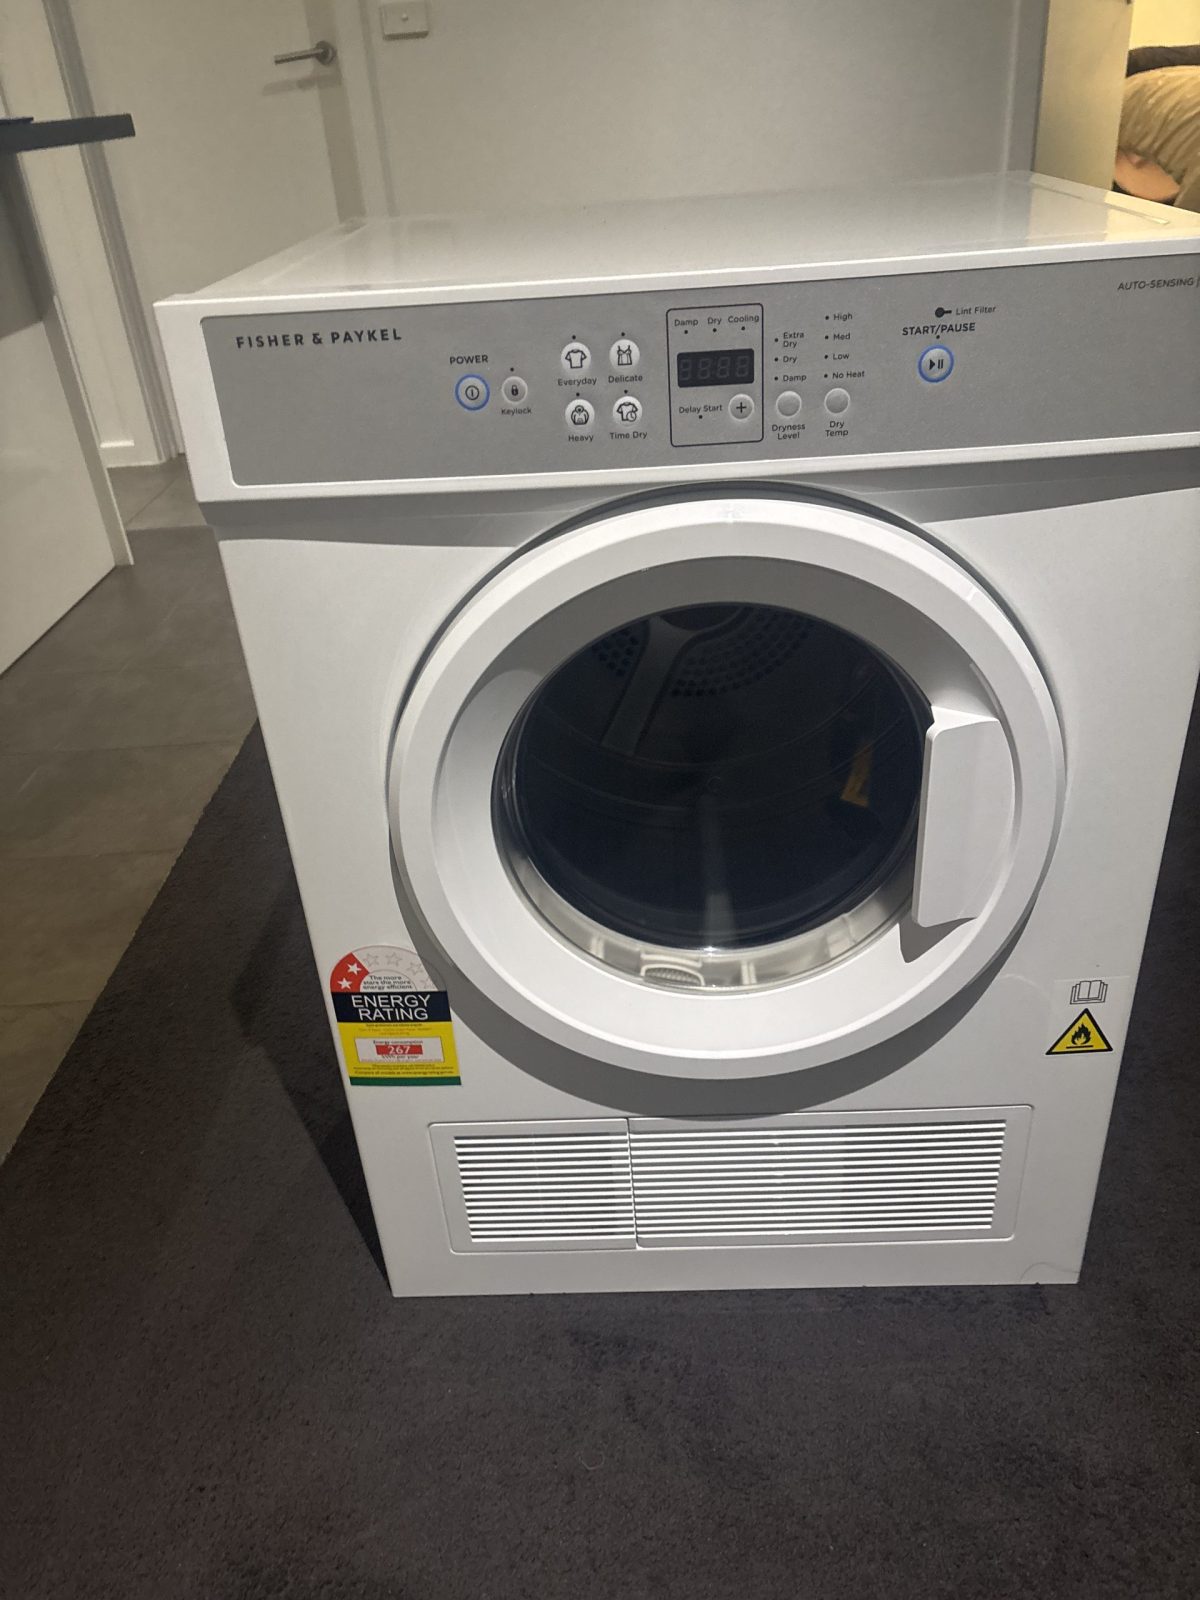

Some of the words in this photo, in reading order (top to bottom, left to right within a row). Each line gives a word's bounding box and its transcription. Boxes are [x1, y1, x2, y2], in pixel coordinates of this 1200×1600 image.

[1117, 277, 1194, 291] AUTO-SENSING
[955, 306, 972, 316] Lint
[974, 305, 996, 315] Filter
[674, 318, 698, 328] Damp
[707, 317, 722, 326] Dry
[728, 314, 760, 324] Cooling
[833, 313, 853, 322] High
[902, 321, 976, 336] START/PAUSE
[236, 333, 304, 349] FISHER
[312, 333, 323, 345] &
[331, 328, 402, 344] PAYKEL
[783, 331, 804, 340] Extra
[833, 332, 851, 341] Med
[783, 340, 798, 348] Dry
[449, 354, 489, 365] POWER
[782, 355, 798, 364] Dry
[832, 353, 849, 361] Low
[608, 375, 643, 384] Delicate
[782, 374, 807, 383] Damp
[832, 372, 844, 380] No
[846, 370, 865, 379] Heat
[557, 376, 597, 387] Everyday
[501, 406, 532, 416] Keylock
[678, 406, 702, 415] Delay
[703, 404, 722, 413] Start
[771, 423, 806, 433] Dryness
[829, 421, 845, 430] Dry
[568, 433, 594, 442] Heavy
[609, 432, 630, 440] Time
[632, 431, 648, 440] Dry
[777, 431, 800, 440] Level
[825, 429, 849, 438] Temp
[351, 994, 431, 1008] ENERGY
[358, 1008, 429, 1021] RATING
[387, 1046, 411, 1054] 267
